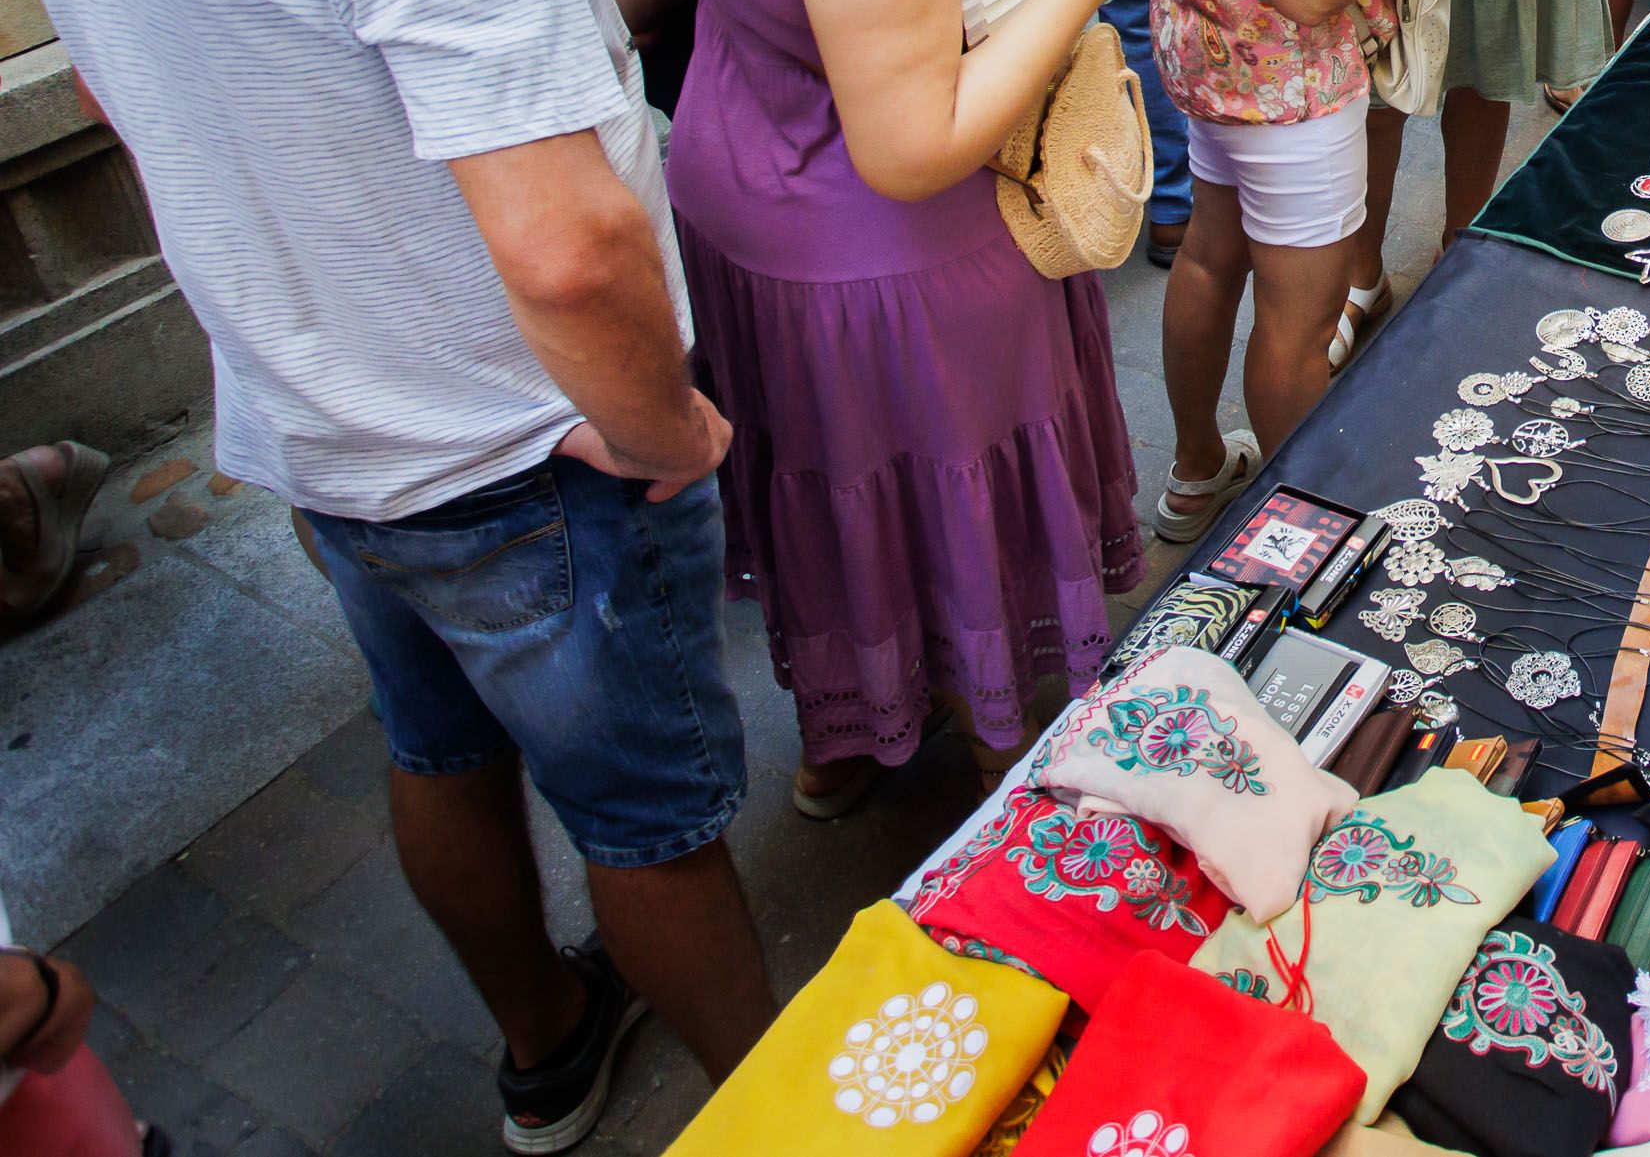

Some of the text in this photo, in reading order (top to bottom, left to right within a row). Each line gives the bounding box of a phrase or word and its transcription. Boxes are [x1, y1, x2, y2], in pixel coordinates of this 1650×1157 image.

[1328, 550, 1355, 583] X-ZONE
[1224, 624, 1256, 660] X-ZONE
[1258, 673, 1288, 709] MOR
[1273, 691, 1293, 708] IS
[1280, 683, 1314, 723] LESS
[1321, 700, 1353, 739] X-ZONE
